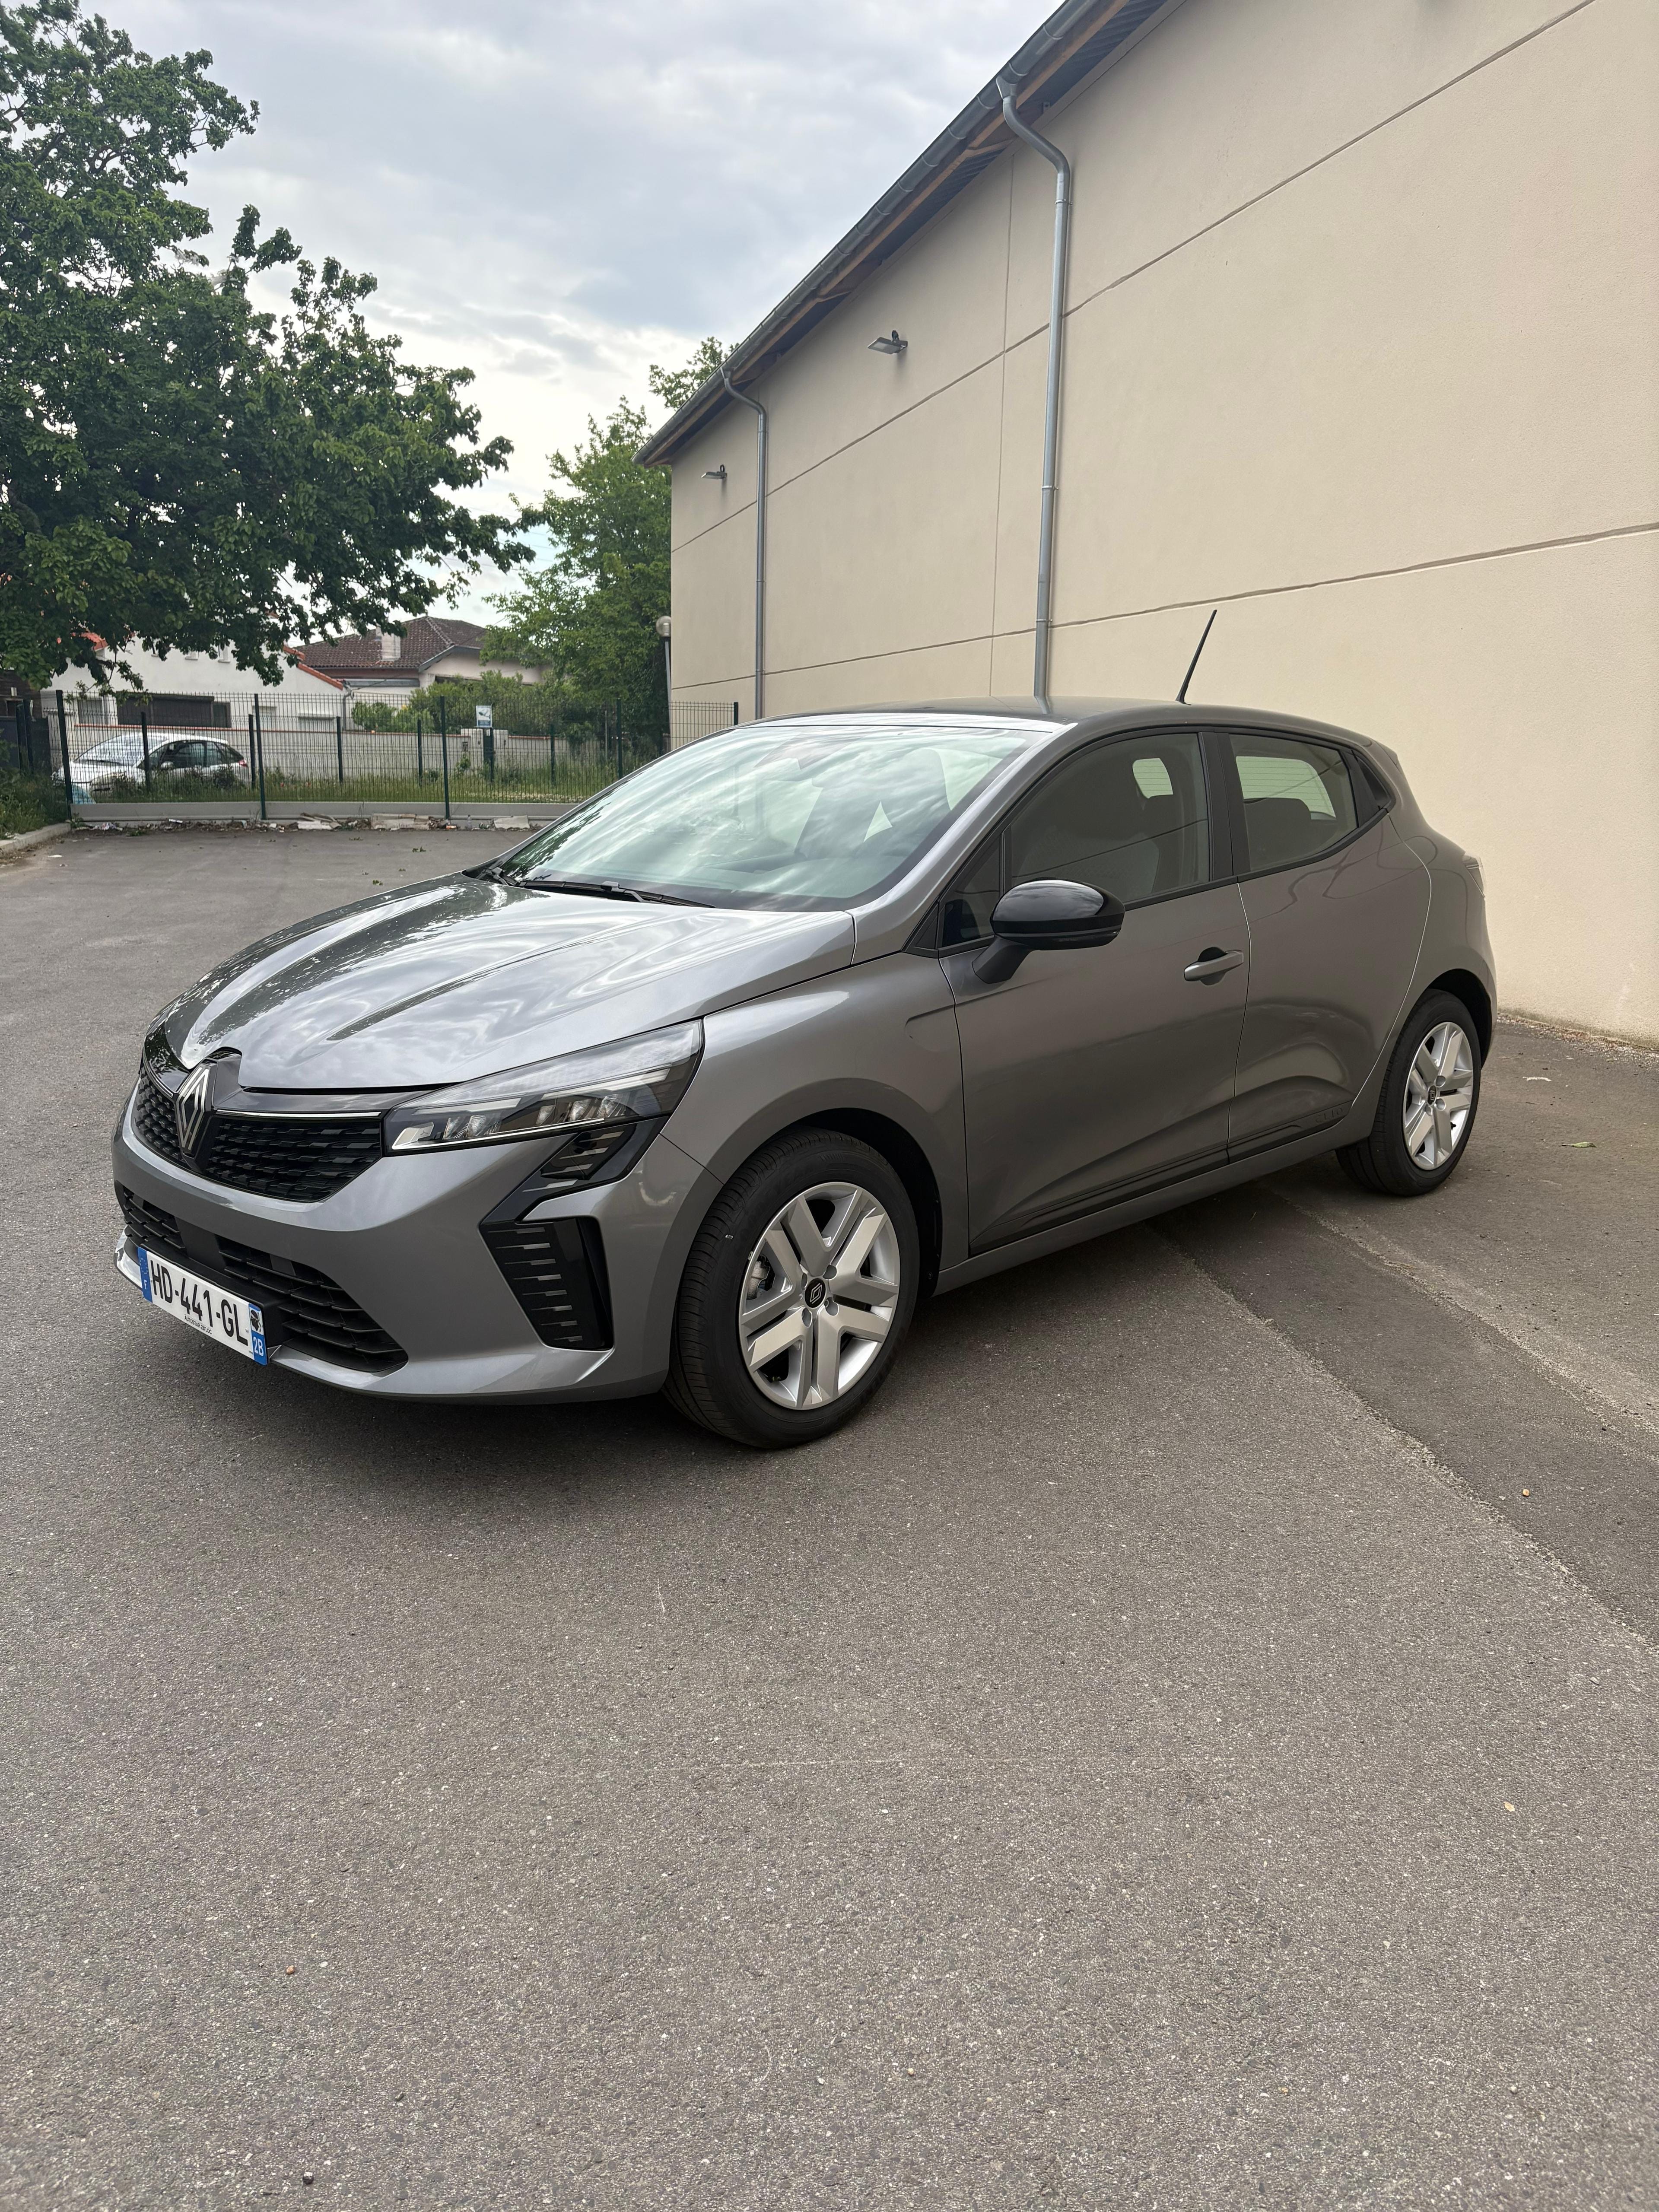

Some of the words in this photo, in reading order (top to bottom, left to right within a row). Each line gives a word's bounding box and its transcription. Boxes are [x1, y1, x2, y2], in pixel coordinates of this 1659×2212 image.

[144, 1280, 147, 1290] F
[151, 1260, 248, 1346] HD-441-GL
[253, 1337, 264, 1356] 2B
